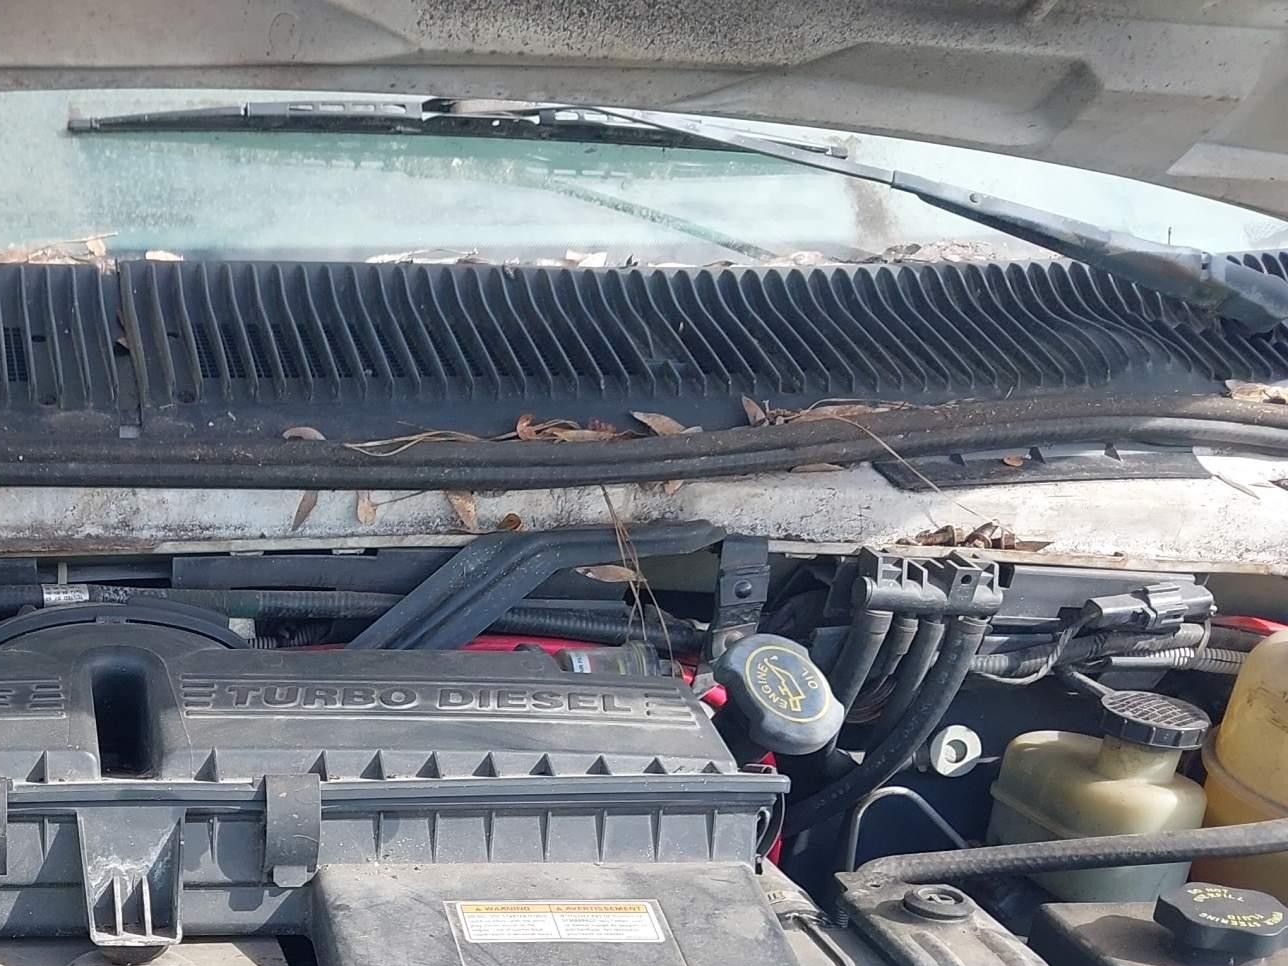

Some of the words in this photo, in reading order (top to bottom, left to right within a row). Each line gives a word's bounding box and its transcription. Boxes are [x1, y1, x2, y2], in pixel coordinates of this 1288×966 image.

[756, 662, 788, 709] ENGINE
[802, 667, 818, 689] OIL
[227, 684, 420, 710] TURBO
[437, 687, 634, 714] DIESEL
